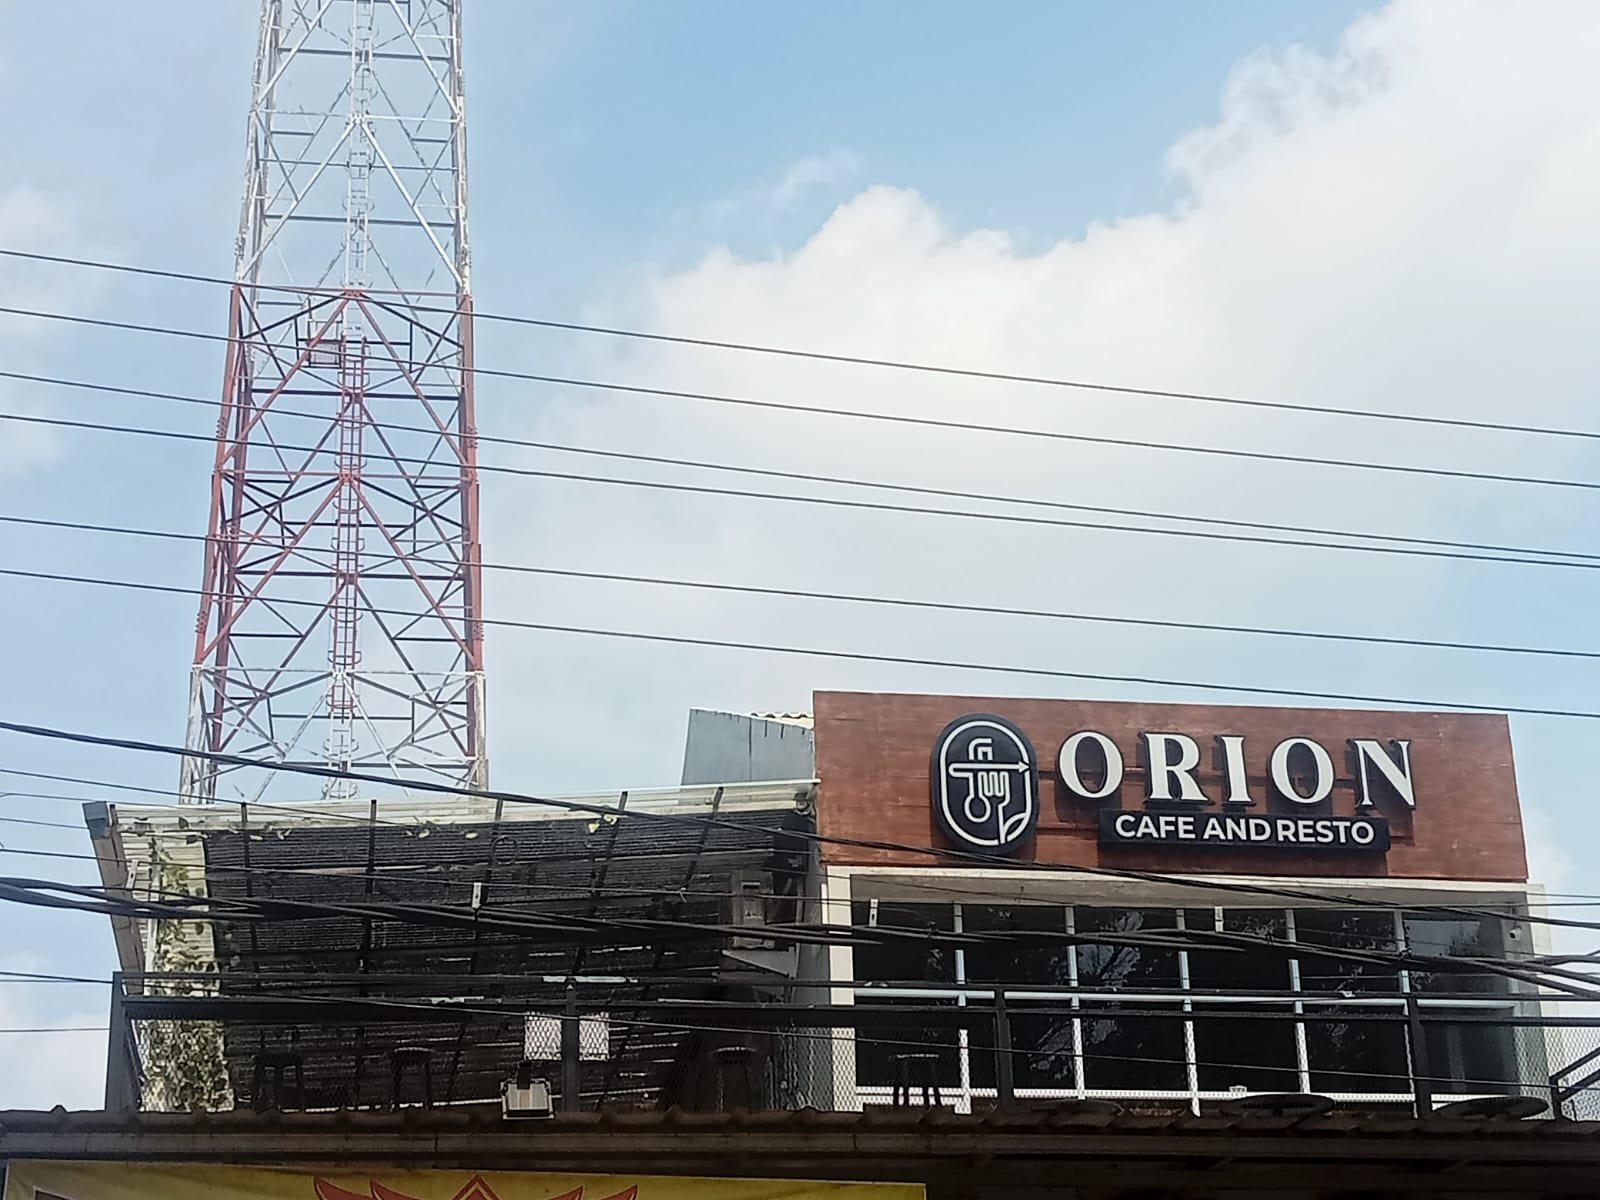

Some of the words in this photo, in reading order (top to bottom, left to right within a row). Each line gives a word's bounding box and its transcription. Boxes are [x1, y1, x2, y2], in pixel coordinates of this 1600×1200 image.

[1058, 731, 1415, 807] ORION
[1114, 814, 1196, 839] CAFE
[1203, 816, 1272, 842] AND
[1277, 818, 1375, 844] RESTO
